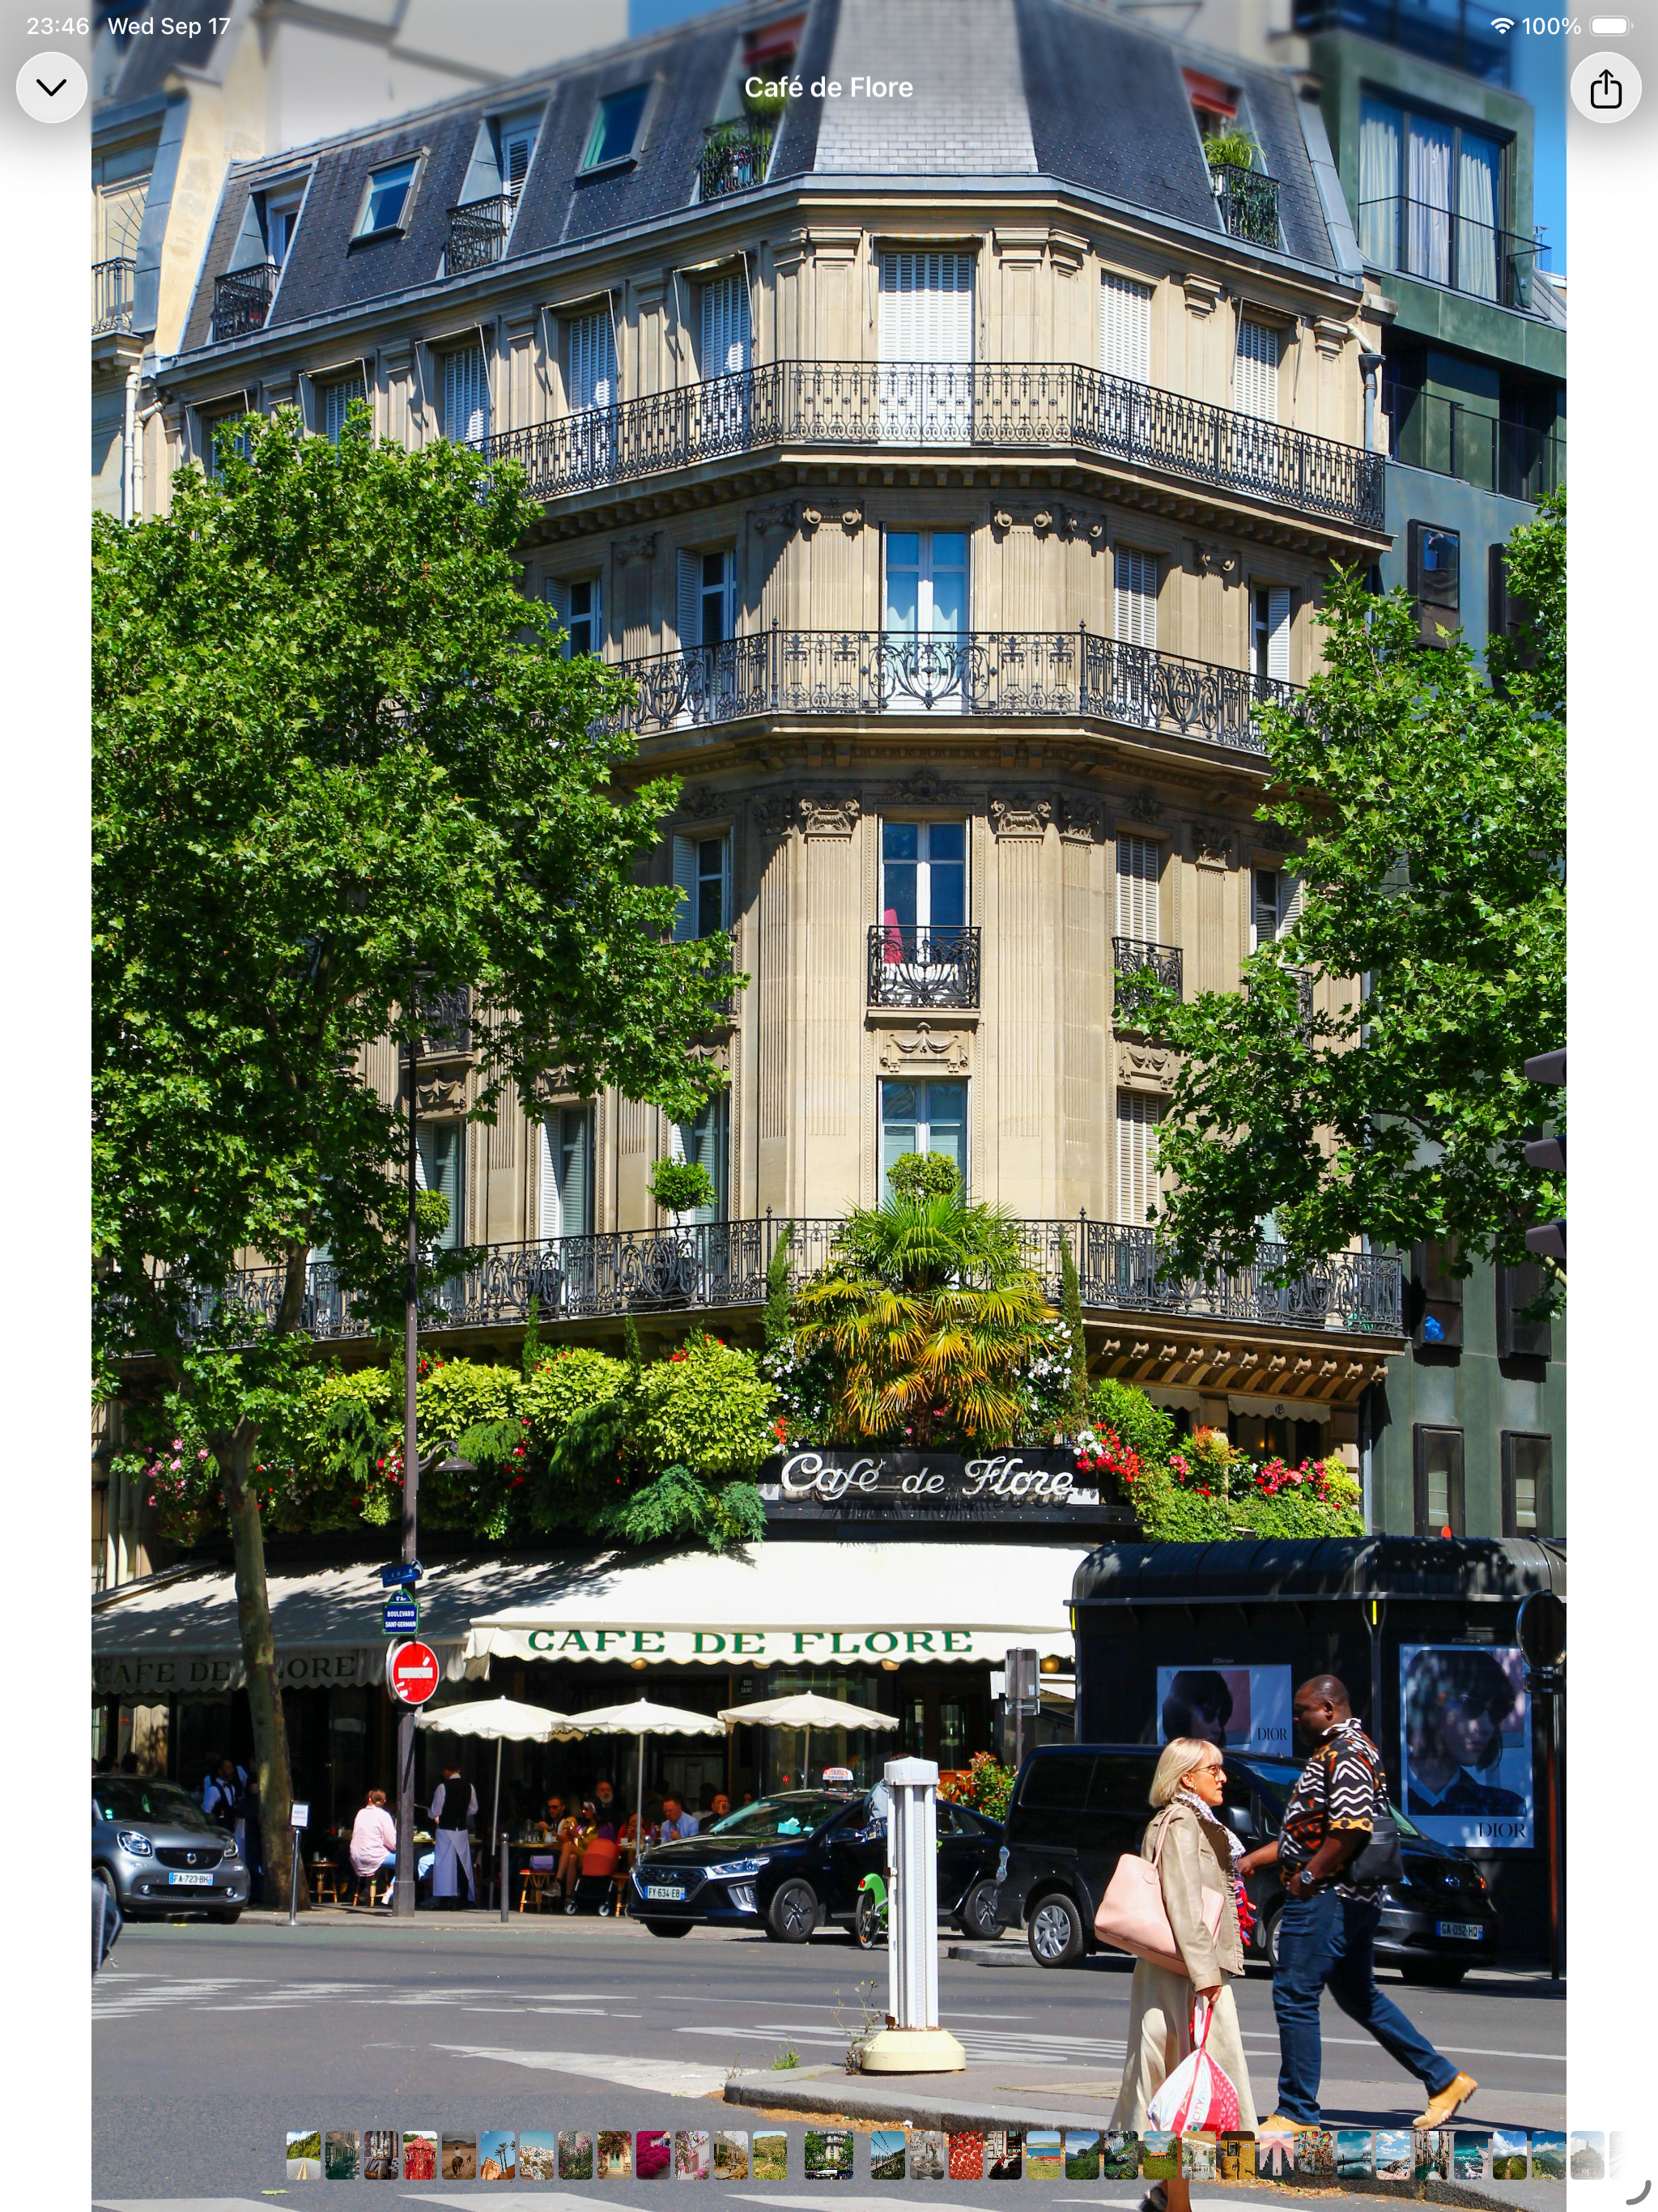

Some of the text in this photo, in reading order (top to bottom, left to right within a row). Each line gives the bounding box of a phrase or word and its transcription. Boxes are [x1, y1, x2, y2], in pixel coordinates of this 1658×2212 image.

[780, 1452, 1075, 1502] Café de Flore
[528, 1629, 973, 1654] CAFE DE FLORE
[94, 1657, 355, 1685] CAFE DE ORE
[1257, 1727, 1288, 1741] DIOR
[1477, 1823, 1528, 1839] DIOR
